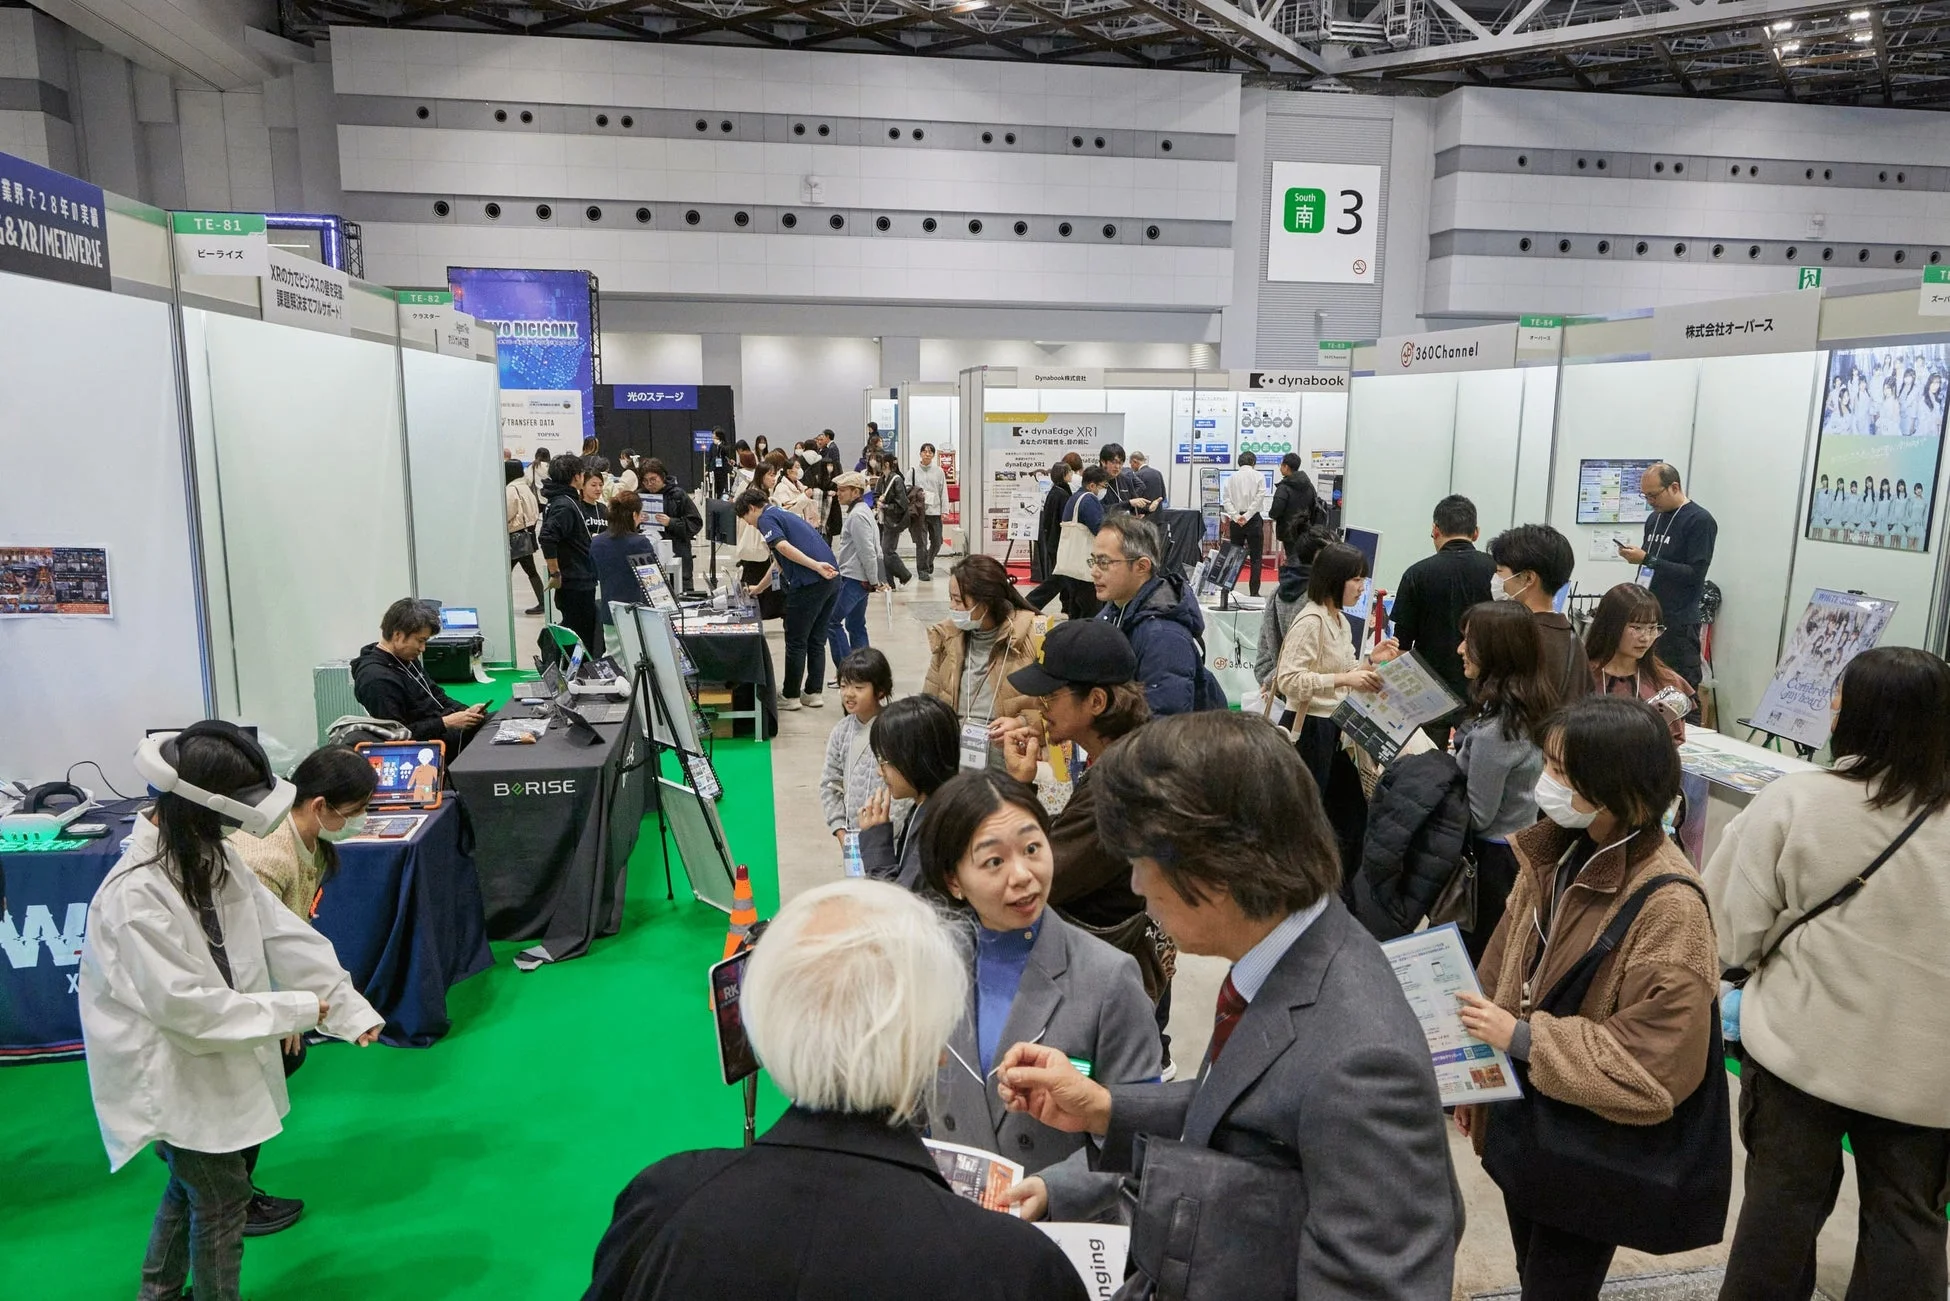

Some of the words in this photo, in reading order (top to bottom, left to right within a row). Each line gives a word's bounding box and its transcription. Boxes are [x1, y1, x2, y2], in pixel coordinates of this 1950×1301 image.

[1295, 193, 1316, 202] South
[1296, 204, 1314, 229] 南
[1337, 189, 1363, 235] 3
[194, 218, 242, 231] TE-81
[198, 249, 243, 260] ビーライズ
[411, 294, 440, 303] TE-82
[514, 322, 577, 337] DIGICONX
[1685, 318, 1774, 339] 株式会社オーバース
[1416, 341, 1479, 361] 360Channel
[1278, 375, 1344, 387] dynabook
[627, 391, 684, 402] 光のステージ
[507, 418, 538, 426] TRANSFER
[540, 418, 555, 426] DATA
[1031, 427, 1074, 436] dynaEdge
[1089, 1239, 1112, 1301] nging
